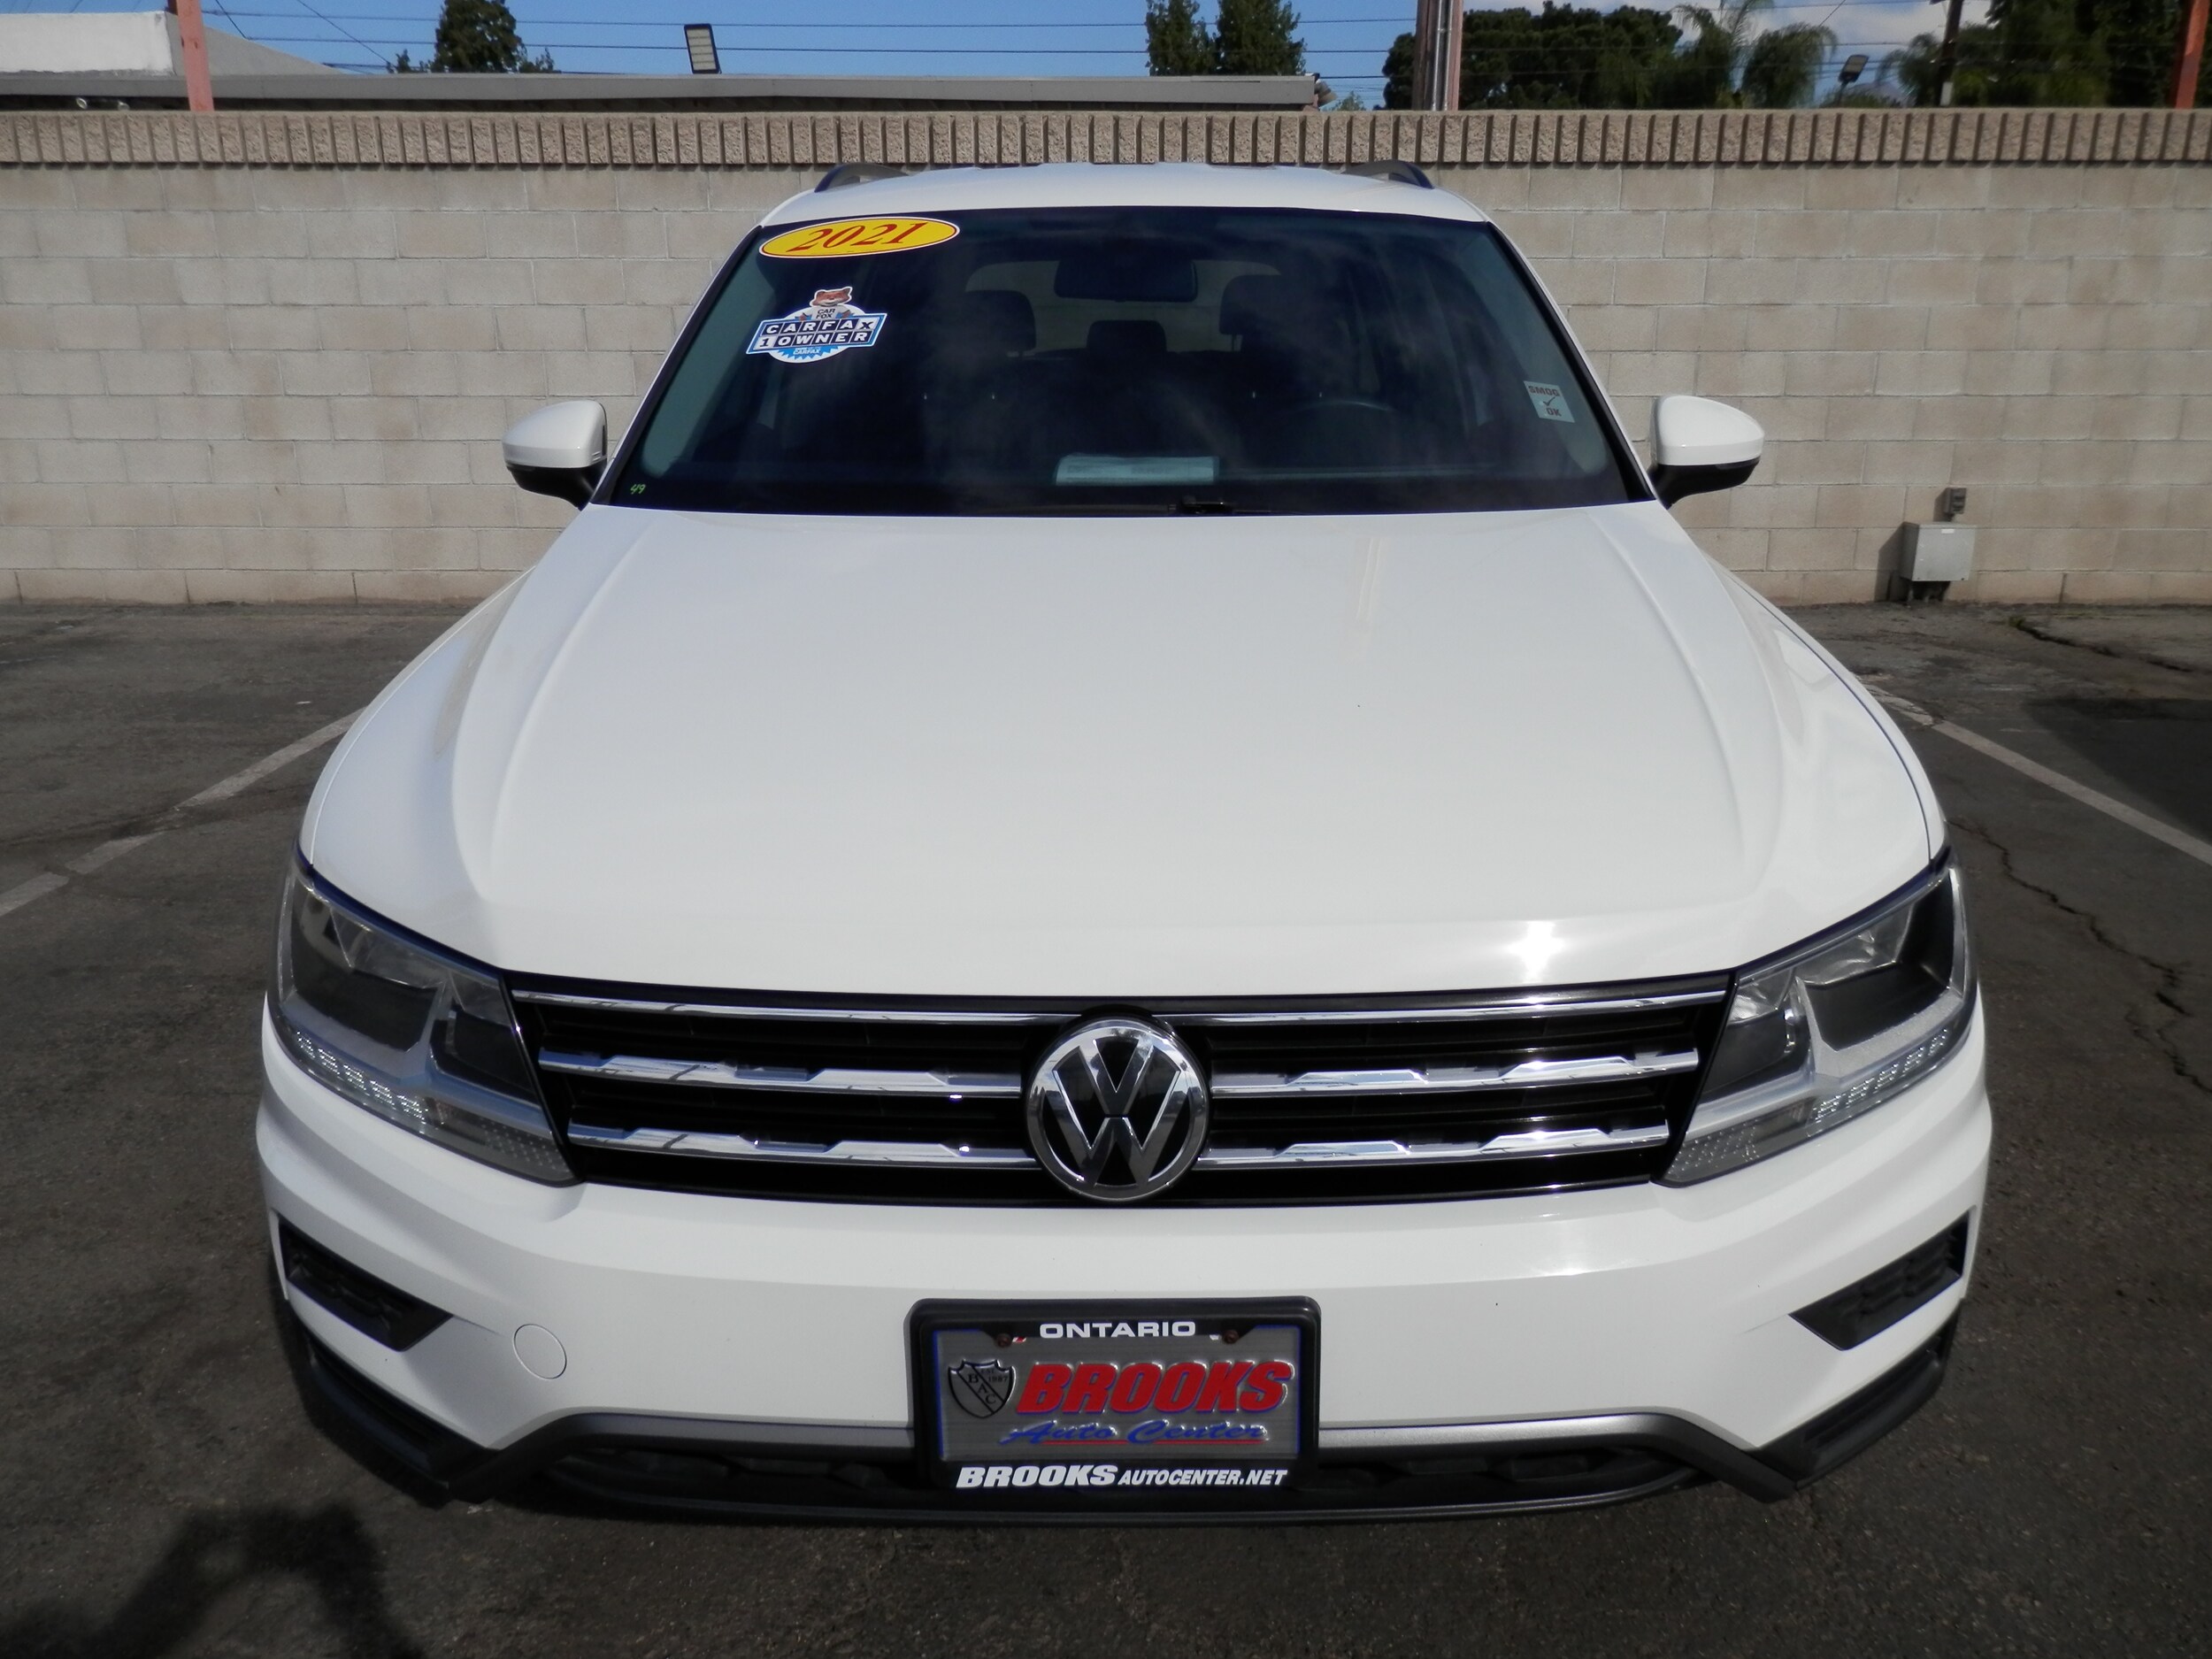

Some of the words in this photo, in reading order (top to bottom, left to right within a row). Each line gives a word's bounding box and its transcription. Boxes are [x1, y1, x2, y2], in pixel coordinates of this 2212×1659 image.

[786, 222, 928, 253] 2021
[765, 319, 874, 334] CARFAX
[778, 332, 867, 347] OWNER
[1528, 385, 1561, 397] SMOG
[1546, 407, 1562, 418] OK
[1037, 1026, 1197, 1193] VW
[1040, 1321, 1196, 1340] ONTARIO
[1016, 1361, 1296, 1415] BROOKS
[999, 1420, 1118, 1446] Auto
[1126, 1418, 1270, 1445] Center
[956, 1464, 1118, 1489] BROOKS
